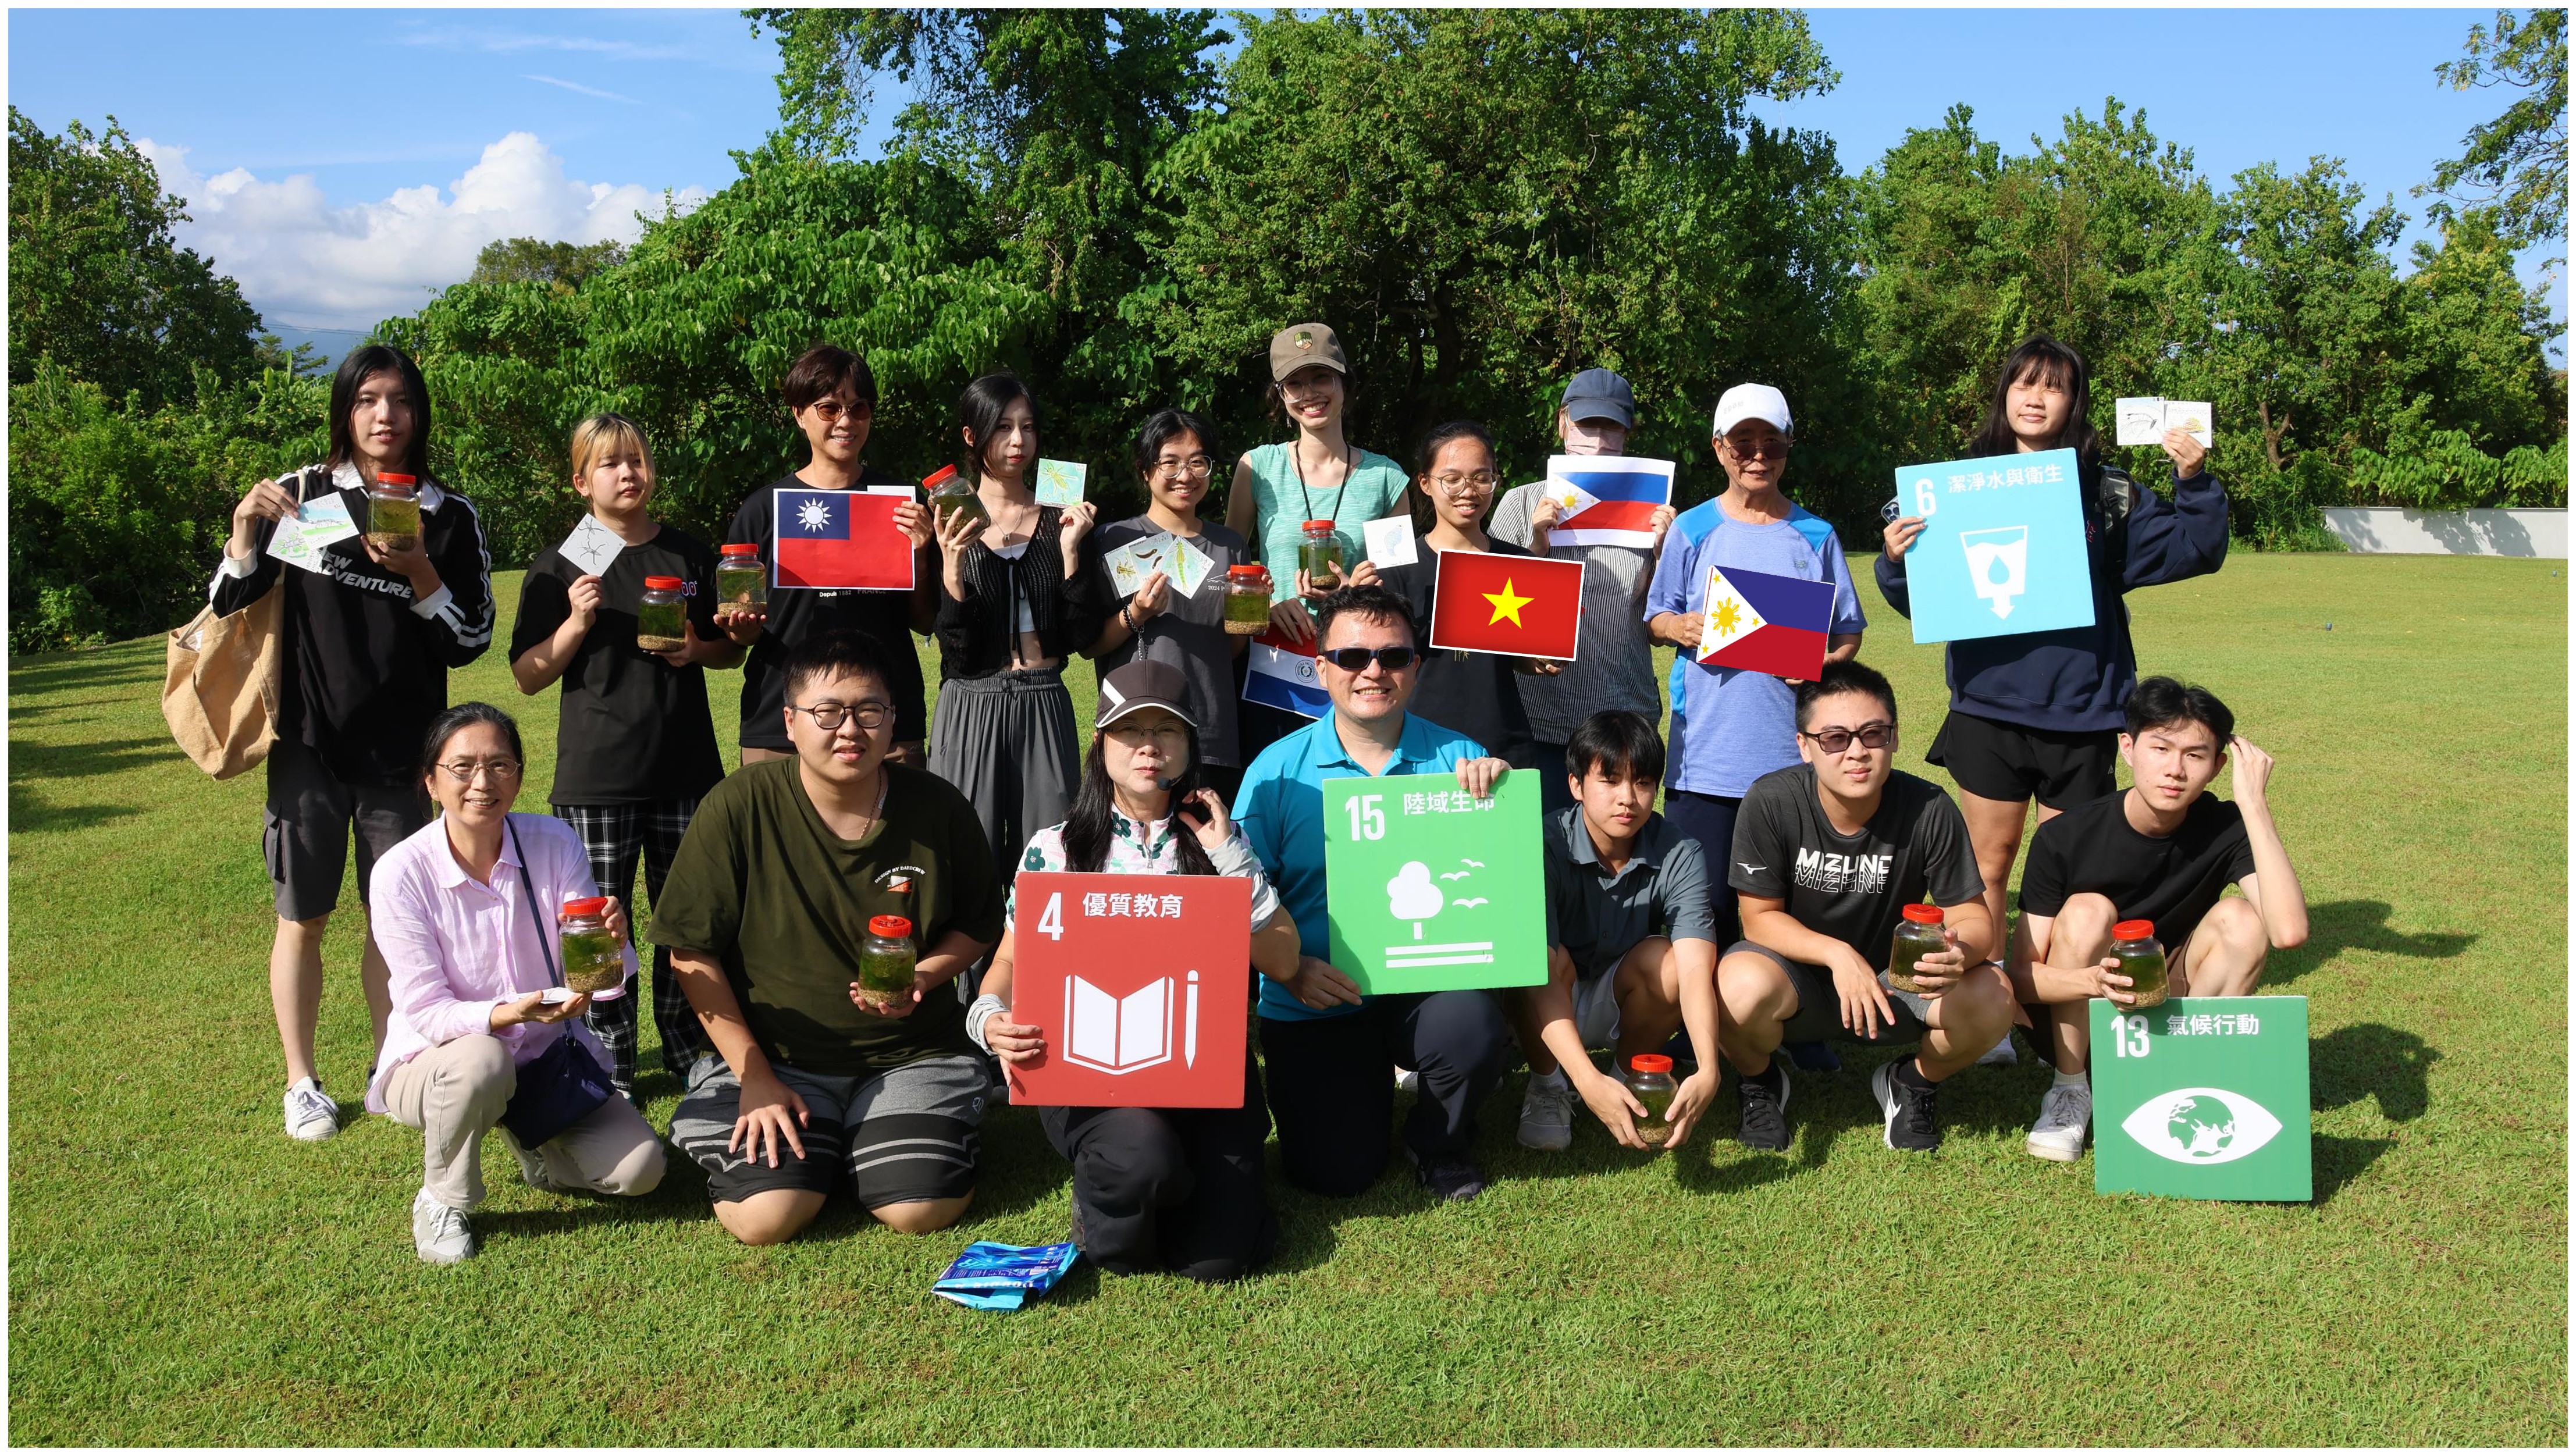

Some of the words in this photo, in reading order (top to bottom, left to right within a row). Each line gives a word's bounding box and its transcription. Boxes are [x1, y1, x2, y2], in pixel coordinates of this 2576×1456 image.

[1915, 478, 1937, 517] 6
[1947, 464, 2064, 494] 潔淨水與衛生
[319, 563, 412, 599] DVENTURE
[1345, 794, 1385, 841] 15
[1037, 892, 1064, 941] 4
[1083, 892, 1183, 918] 優質教育
[2111, 1015, 2150, 1058] 13
[2166, 1014, 2259, 1035] 氣候行動
